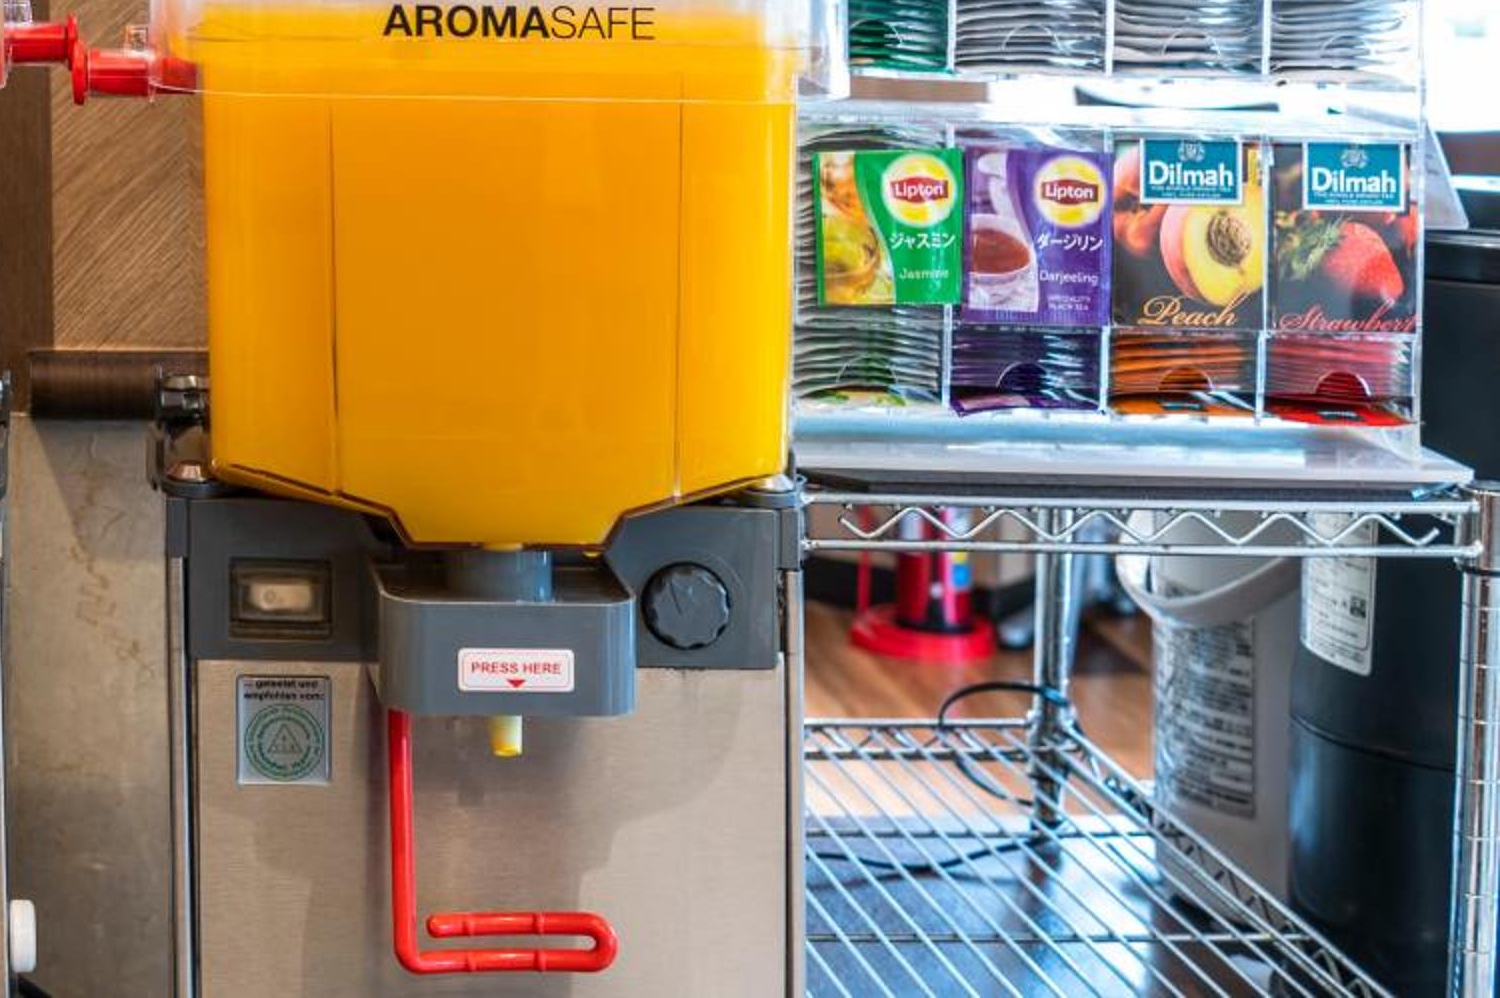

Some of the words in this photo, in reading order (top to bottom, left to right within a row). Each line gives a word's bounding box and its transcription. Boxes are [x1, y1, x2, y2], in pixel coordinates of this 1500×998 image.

[383, 3, 656, 41] AROMASAFE
[1148, 159, 1235, 187] Dilmah
[1311, 166, 1397, 193] Dilmah
[894, 181, 944, 200] Lipton
[1044, 181, 1095, 200] Lipton
[890, 232, 957, 250] ジャスミン
[1037, 233, 1103, 251] ダージリン
[899, 268, 949, 280] Jasmine
[1039, 269, 1099, 287] Darjeeling
[1137, 290, 1244, 327] Peach
[1278, 298, 1417, 333] Strawberr
[471, 661, 519, 674] PRESS
[523, 662, 561, 675] HERE
